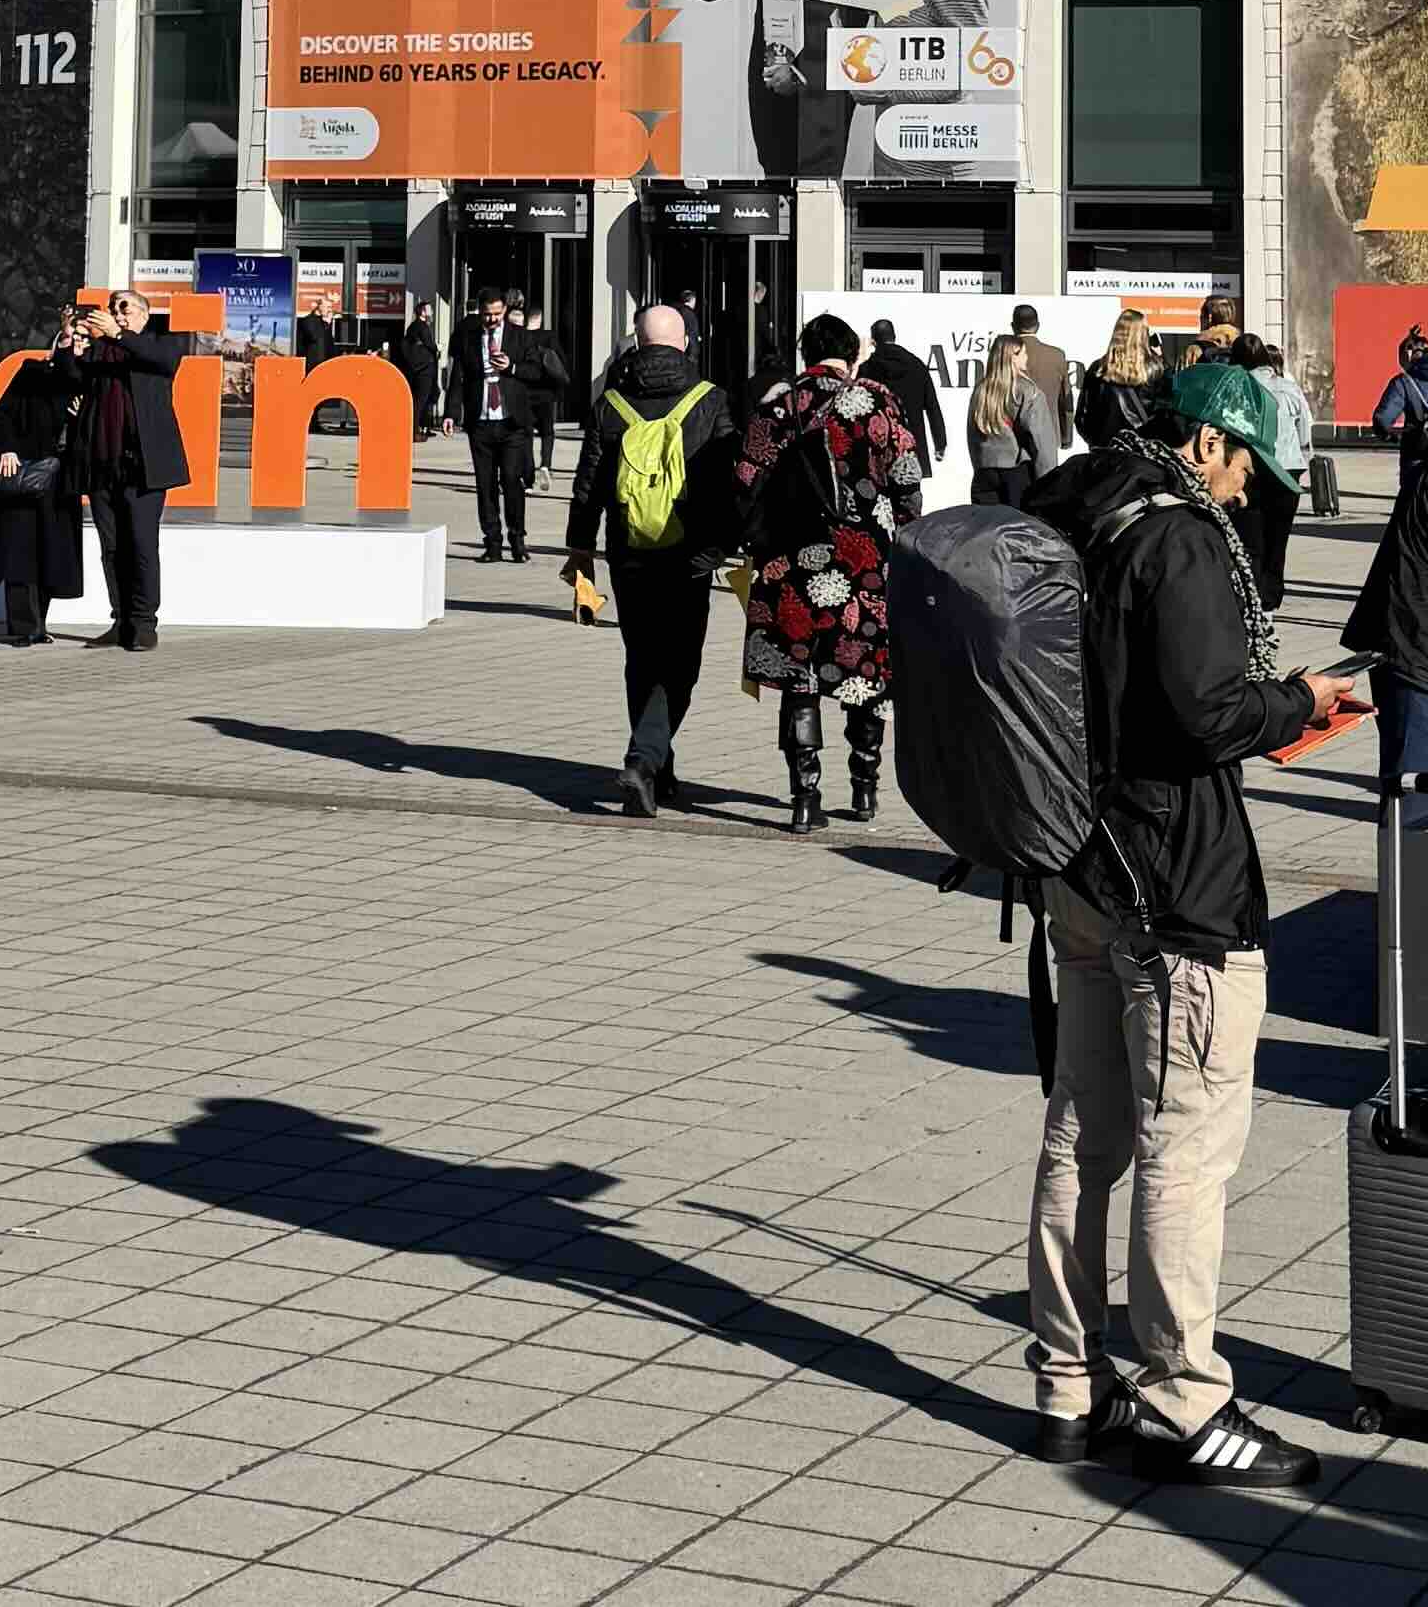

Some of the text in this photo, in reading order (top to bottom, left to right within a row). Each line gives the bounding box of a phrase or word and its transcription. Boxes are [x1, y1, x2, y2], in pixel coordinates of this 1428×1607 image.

[299, 31, 534, 55] DISCOVER THE STORIES
[899, 36, 946, 61] ITB
[15, 31, 77, 86] 112
[300, 61, 606, 84] BEHIND 60 YEARS OF LEGACY.
[899, 67, 946, 81] BERLIN
[933, 125, 978, 136] MESSE
[933, 137, 978, 149] BERLIN
[1074, 279, 1095, 288] FAST
[1097, 280, 1121, 288] LANE
[950, 330, 996, 354] Visi
[927, 344, 1086, 389] Ana
